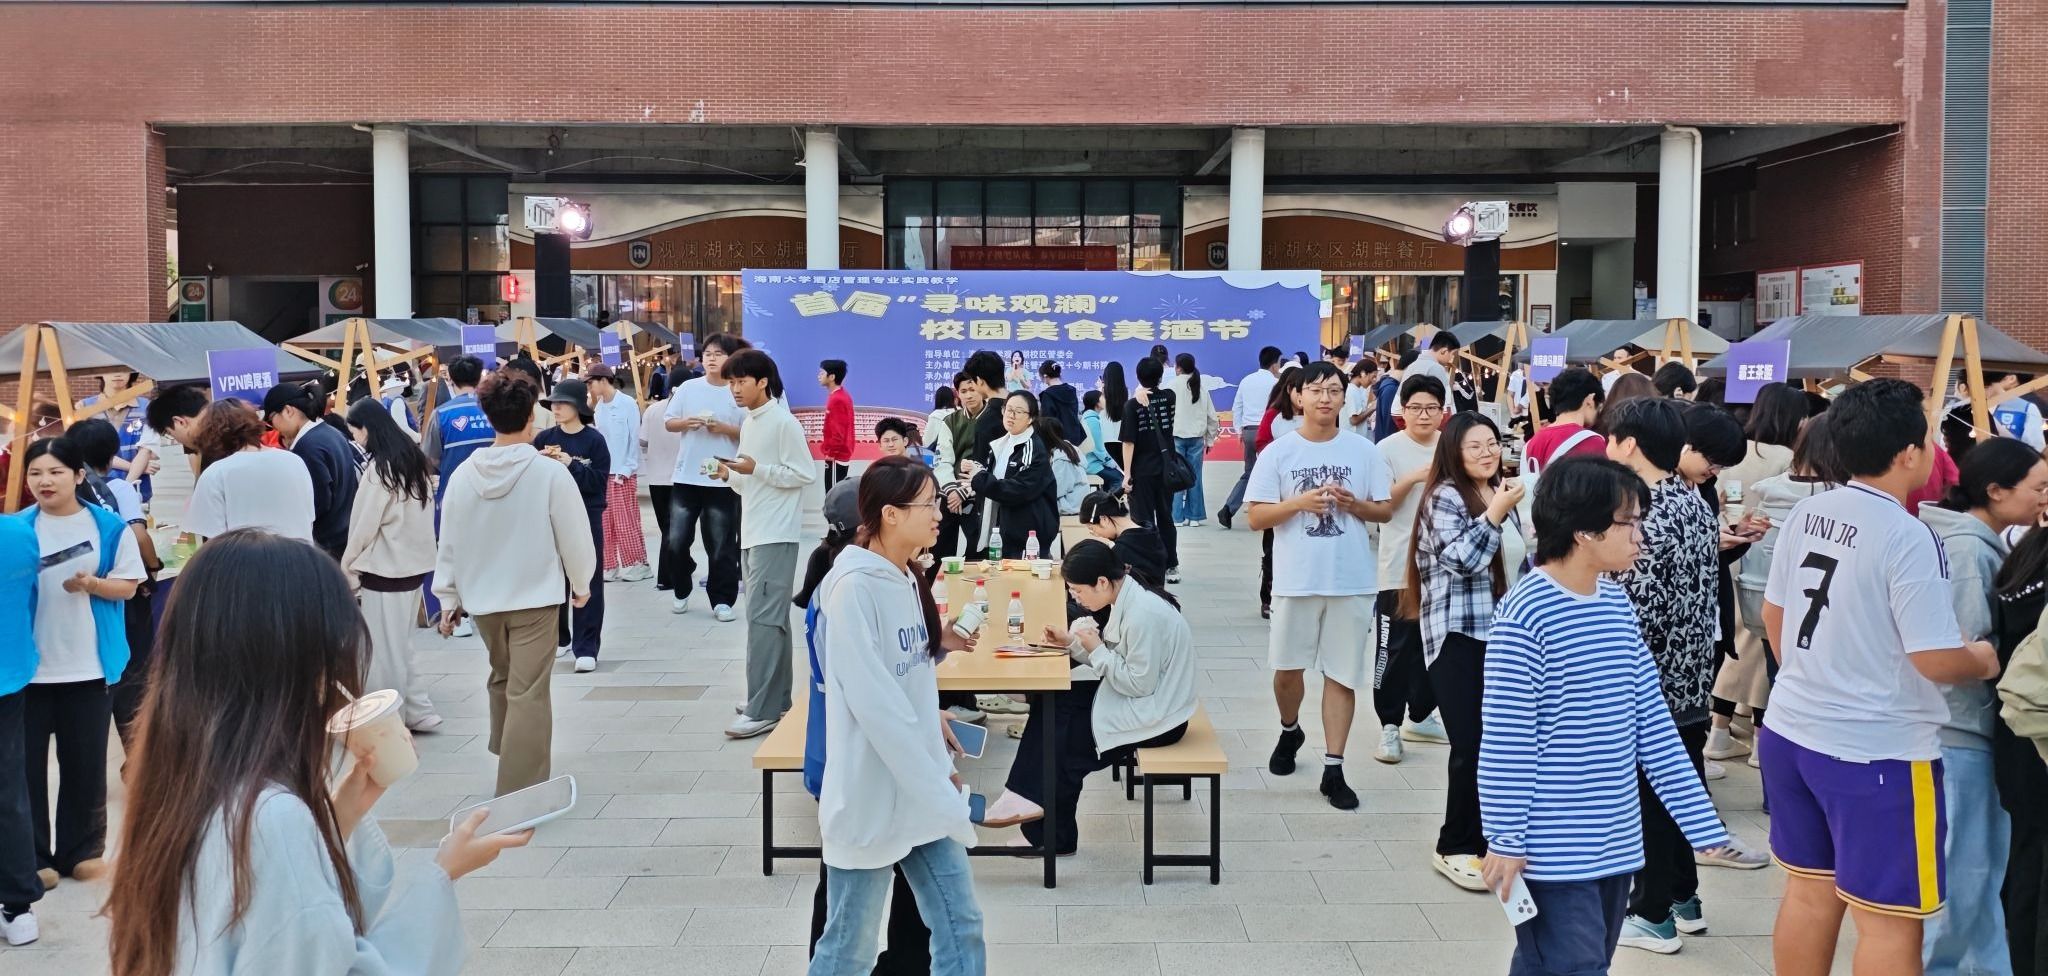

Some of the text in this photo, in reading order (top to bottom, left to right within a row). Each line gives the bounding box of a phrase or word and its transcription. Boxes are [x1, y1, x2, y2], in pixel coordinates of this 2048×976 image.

[1263, 240, 1439, 259] 澜湖校区湖畔餐厅
[753, 275, 959, 285] 海南大学酒店管理专业实践教学
[919, 319, 1252, 341] 校园美食美酒节
[1803, 513, 1859, 550] VINI JR.
[1796, 551, 1840, 651] 7
